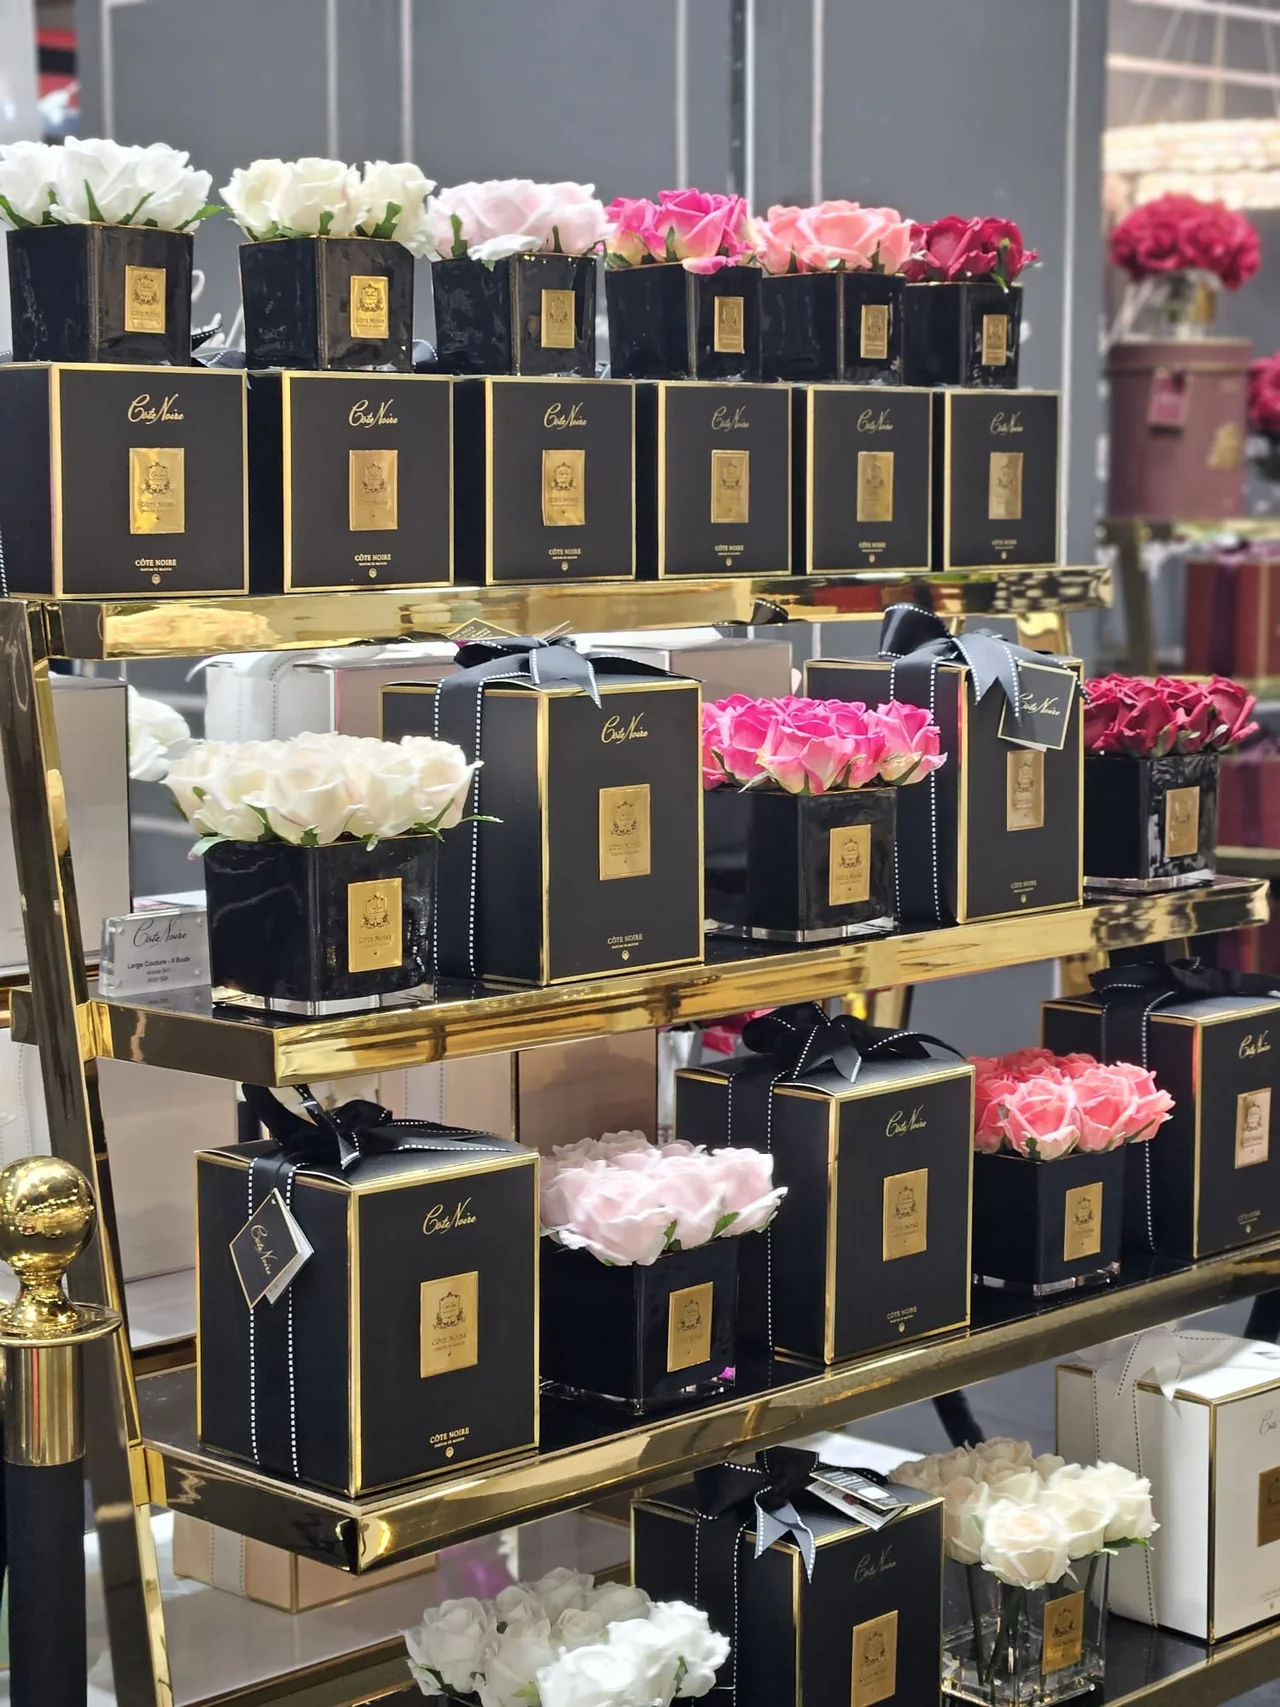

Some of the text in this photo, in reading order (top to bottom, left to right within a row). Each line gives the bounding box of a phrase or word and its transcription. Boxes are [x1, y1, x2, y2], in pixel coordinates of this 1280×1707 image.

[135, 558, 177, 567] CÔTE NOIRE
[354, 553, 392, 562] CÔTE NOIRE
[607, 933, 643, 945] CÔTE NOIRE
[429, 1433, 448, 1445] CÔTE
[448, 1426, 470, 1439] NOIRE
